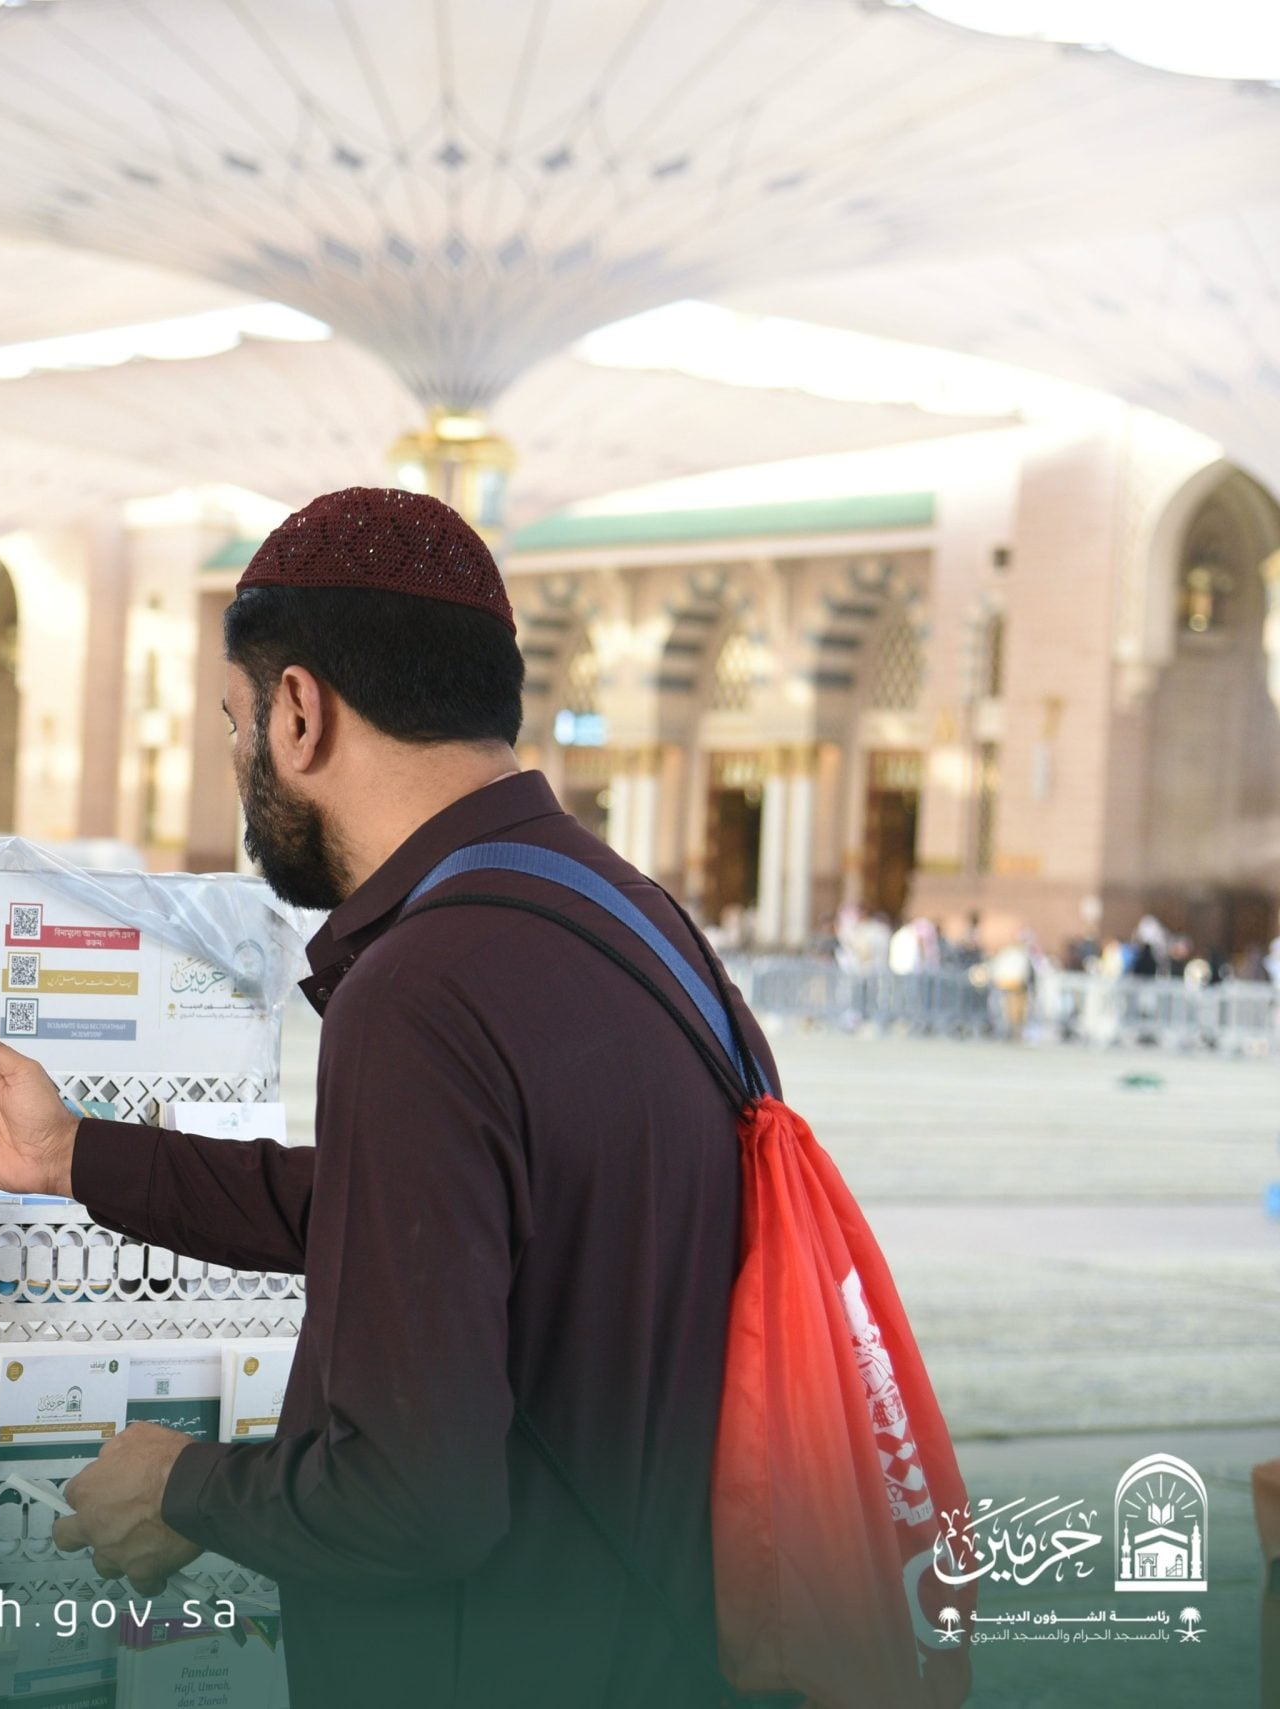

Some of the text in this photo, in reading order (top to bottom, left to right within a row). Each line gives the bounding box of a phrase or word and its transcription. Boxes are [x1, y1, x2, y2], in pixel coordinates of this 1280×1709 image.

[181, 1664, 229, 1679] Panduan
[177, 1695, 228, 1708] dan Ziarah
